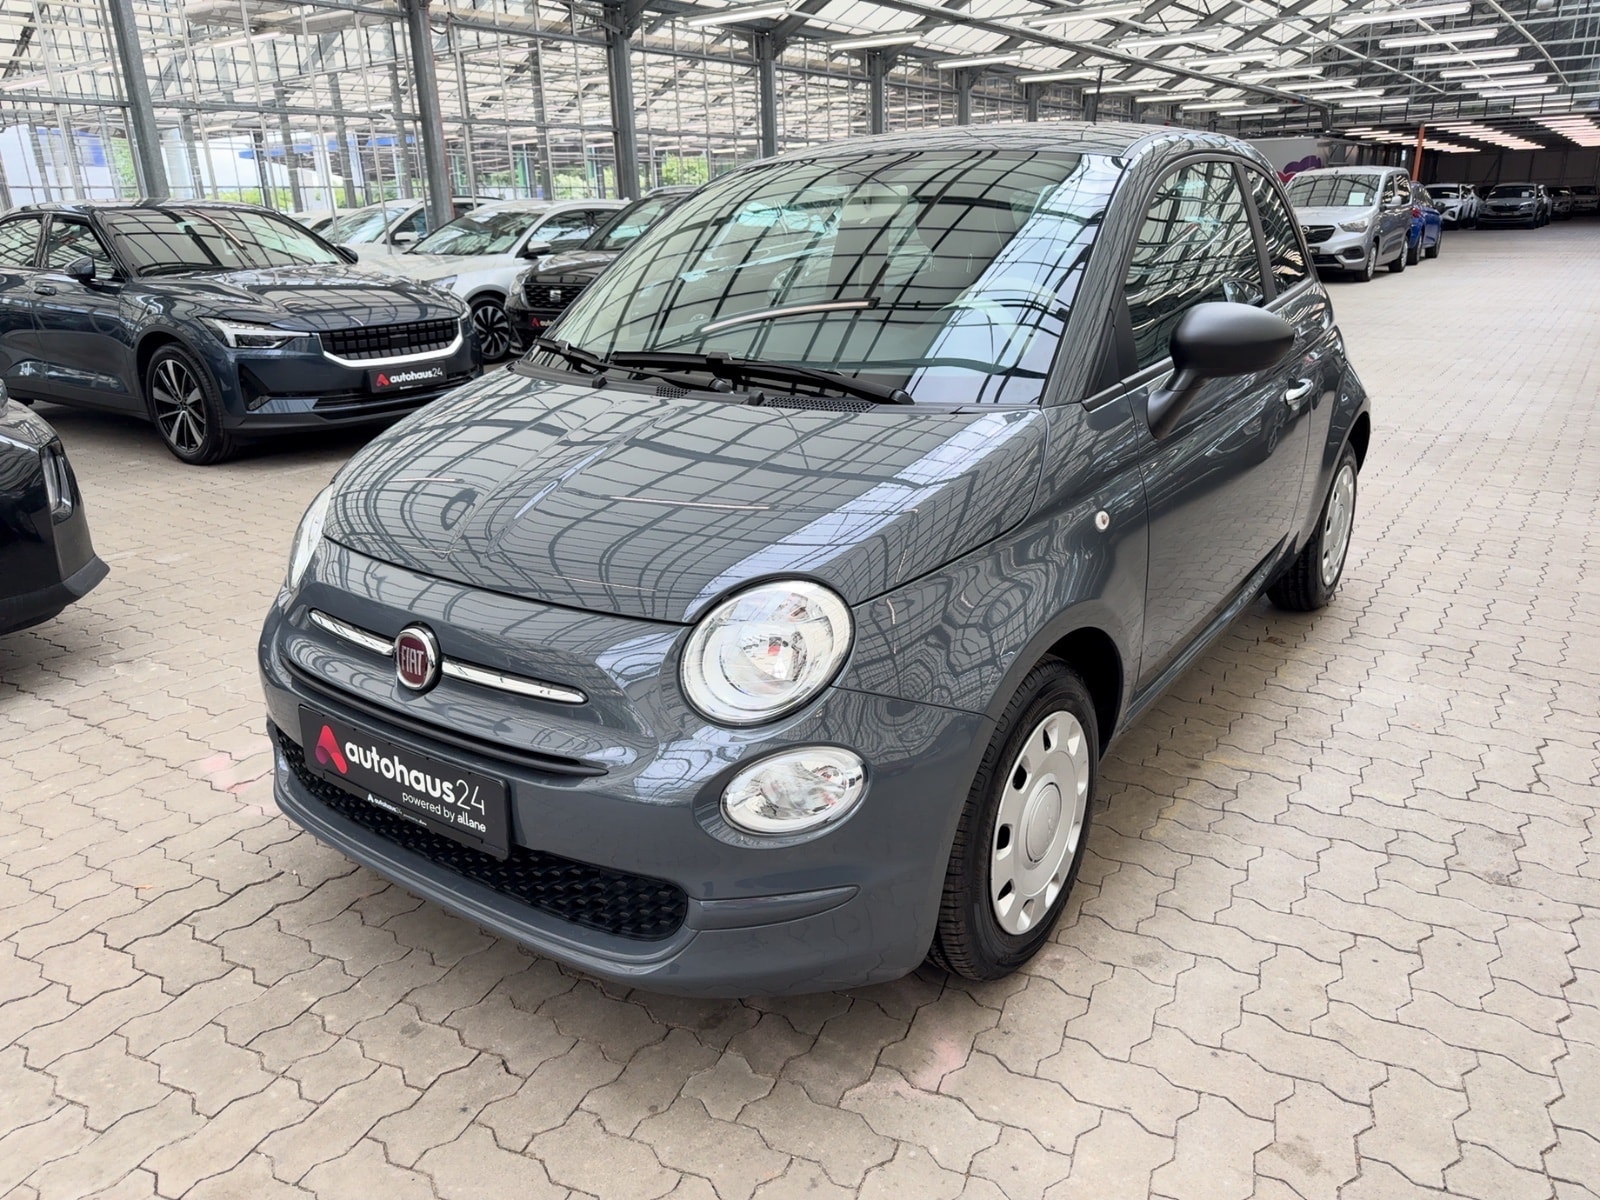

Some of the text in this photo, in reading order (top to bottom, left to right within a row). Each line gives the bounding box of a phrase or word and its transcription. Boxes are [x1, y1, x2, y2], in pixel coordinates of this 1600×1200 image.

[389, 367, 443, 384] autohaus24
[401, 645, 424, 676] FIAT
[345, 741, 485, 815] autohaus24
[402, 792, 441, 815] powered
[443, 806, 455, 823] by
[457, 811, 487, 833] allane
